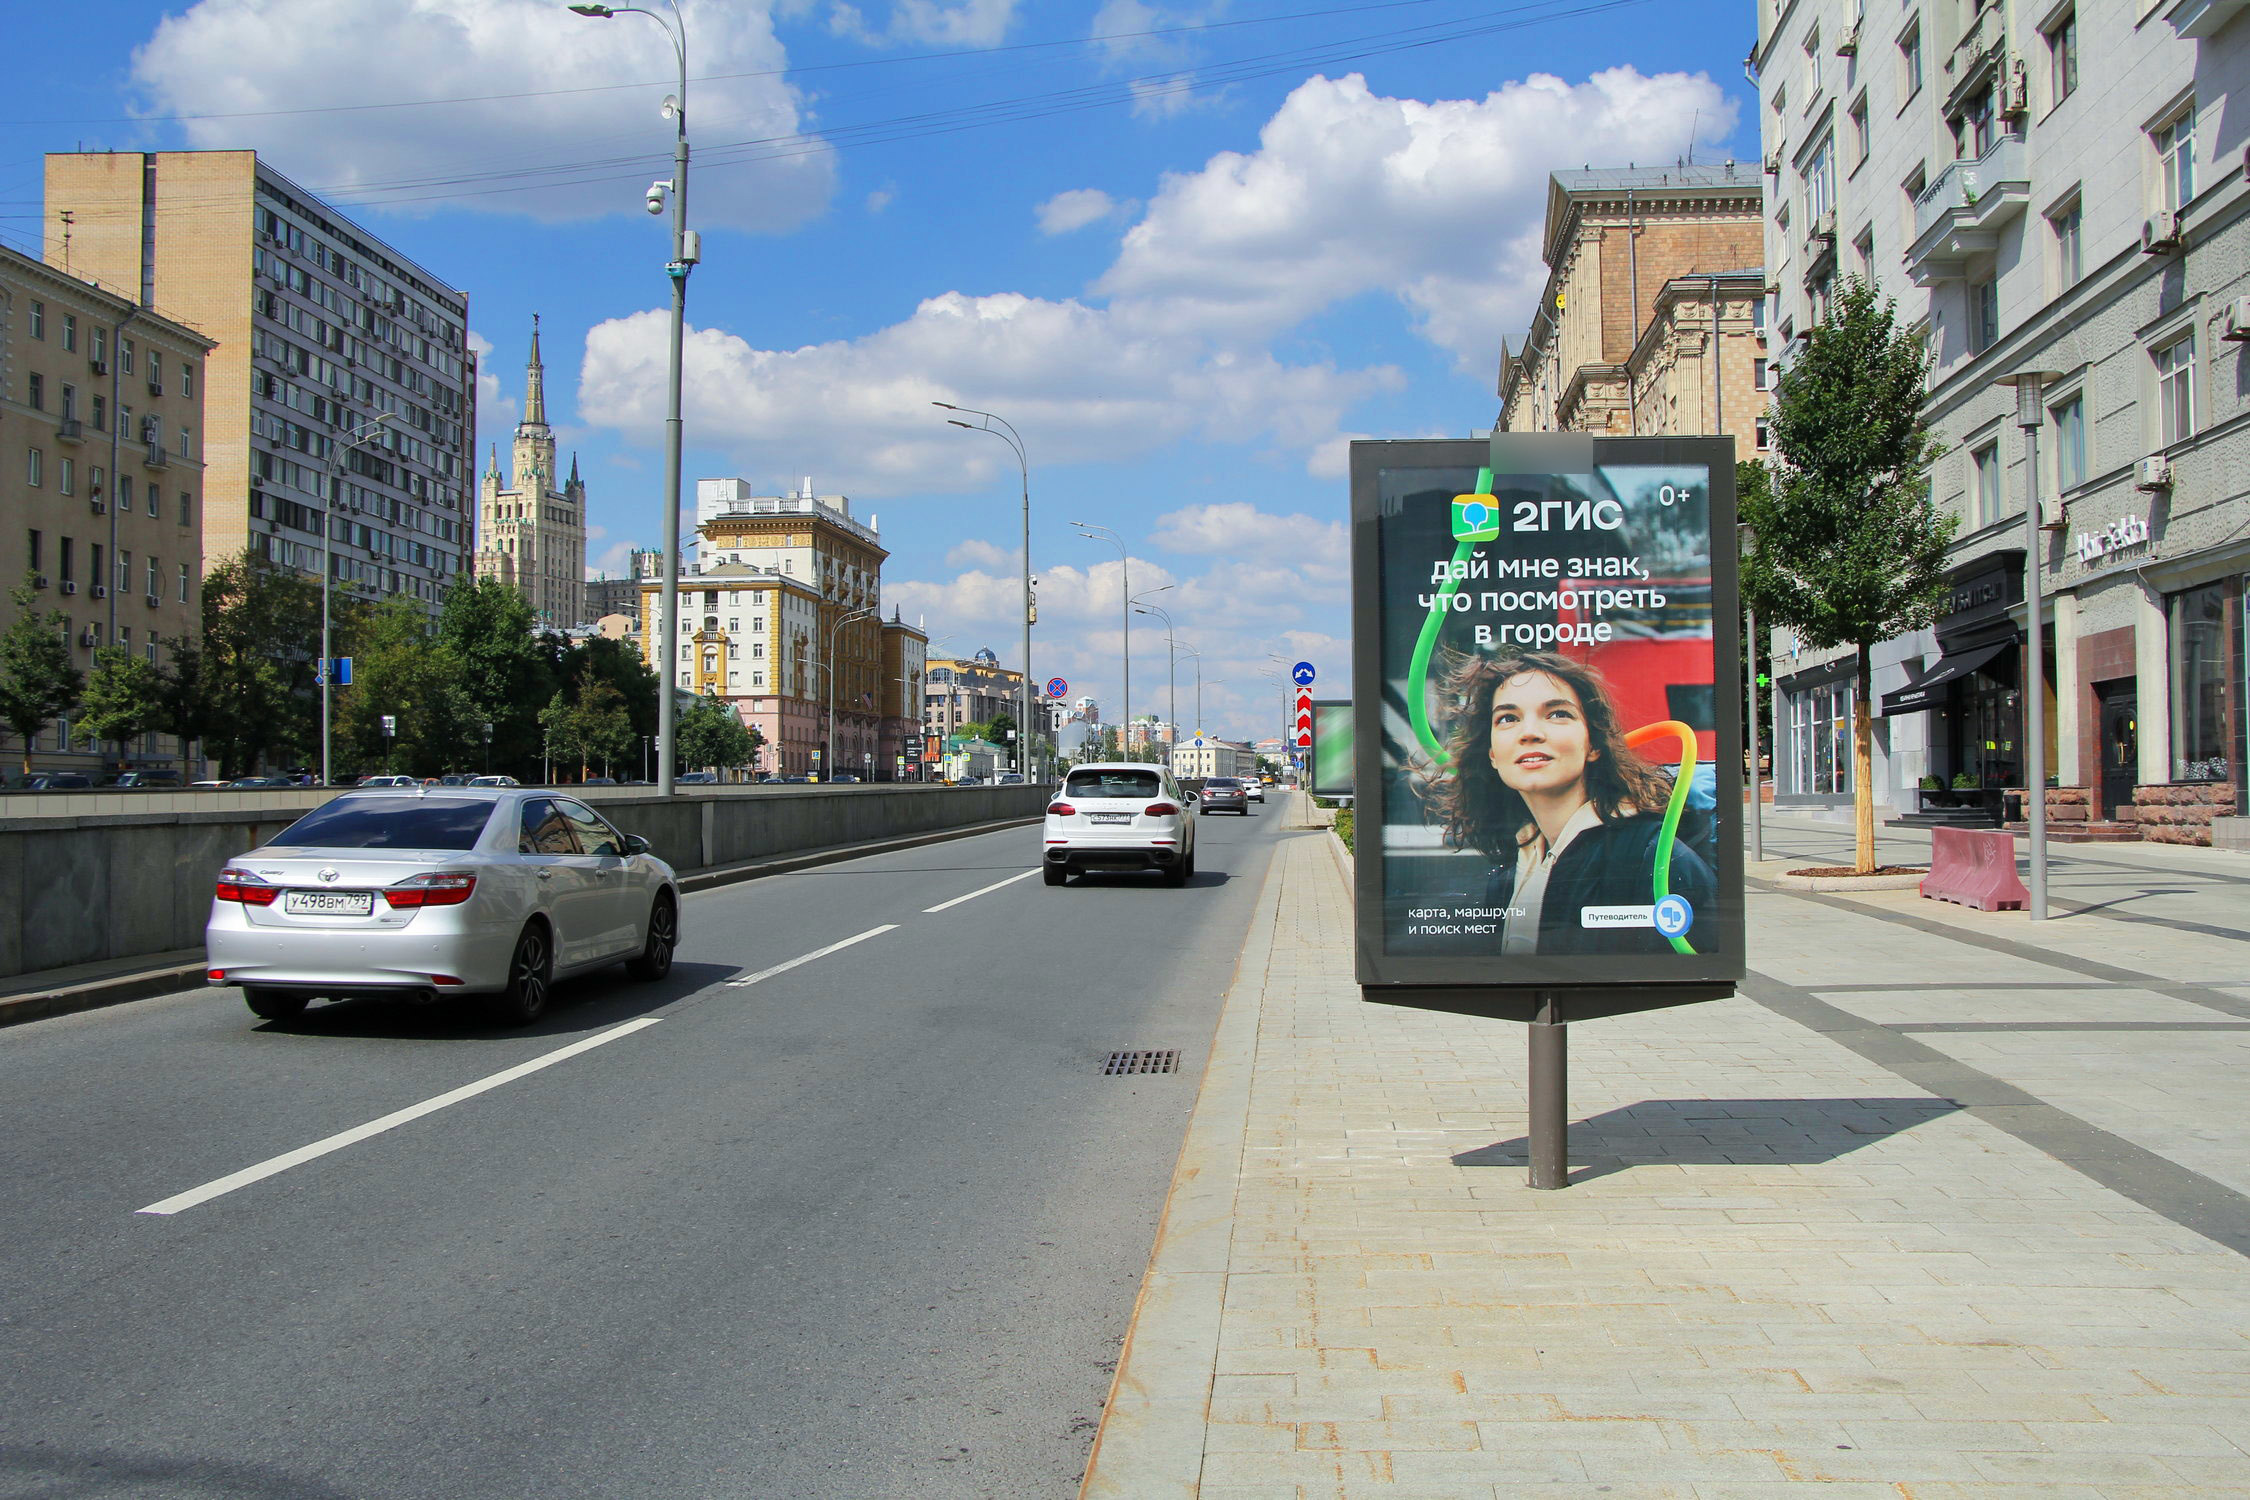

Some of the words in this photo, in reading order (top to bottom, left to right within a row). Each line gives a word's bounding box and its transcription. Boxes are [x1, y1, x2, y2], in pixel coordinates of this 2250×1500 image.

[1659, 485, 1690, 506] 0+
[1512, 500, 1624, 532] 2ГИС
[1431, 551, 1490, 584] дай
[1498, 557, 1560, 579] мне
[1567, 555, 1650, 581] знак,
[1418, 591, 1472, 613] что
[1480, 588, 1667, 616] посмотреть
[1475, 625, 1492, 644] в
[1500, 621, 1613, 650] городе
[1408, 908, 1451, 920] карта,
[1454, 906, 1526, 920] маршруты
[1588, 913, 1648, 922] Путеводитель
[1408, 925, 1417, 934] и
[1420, 924, 1461, 935] поиск
[1464, 923, 1497, 934] мест
